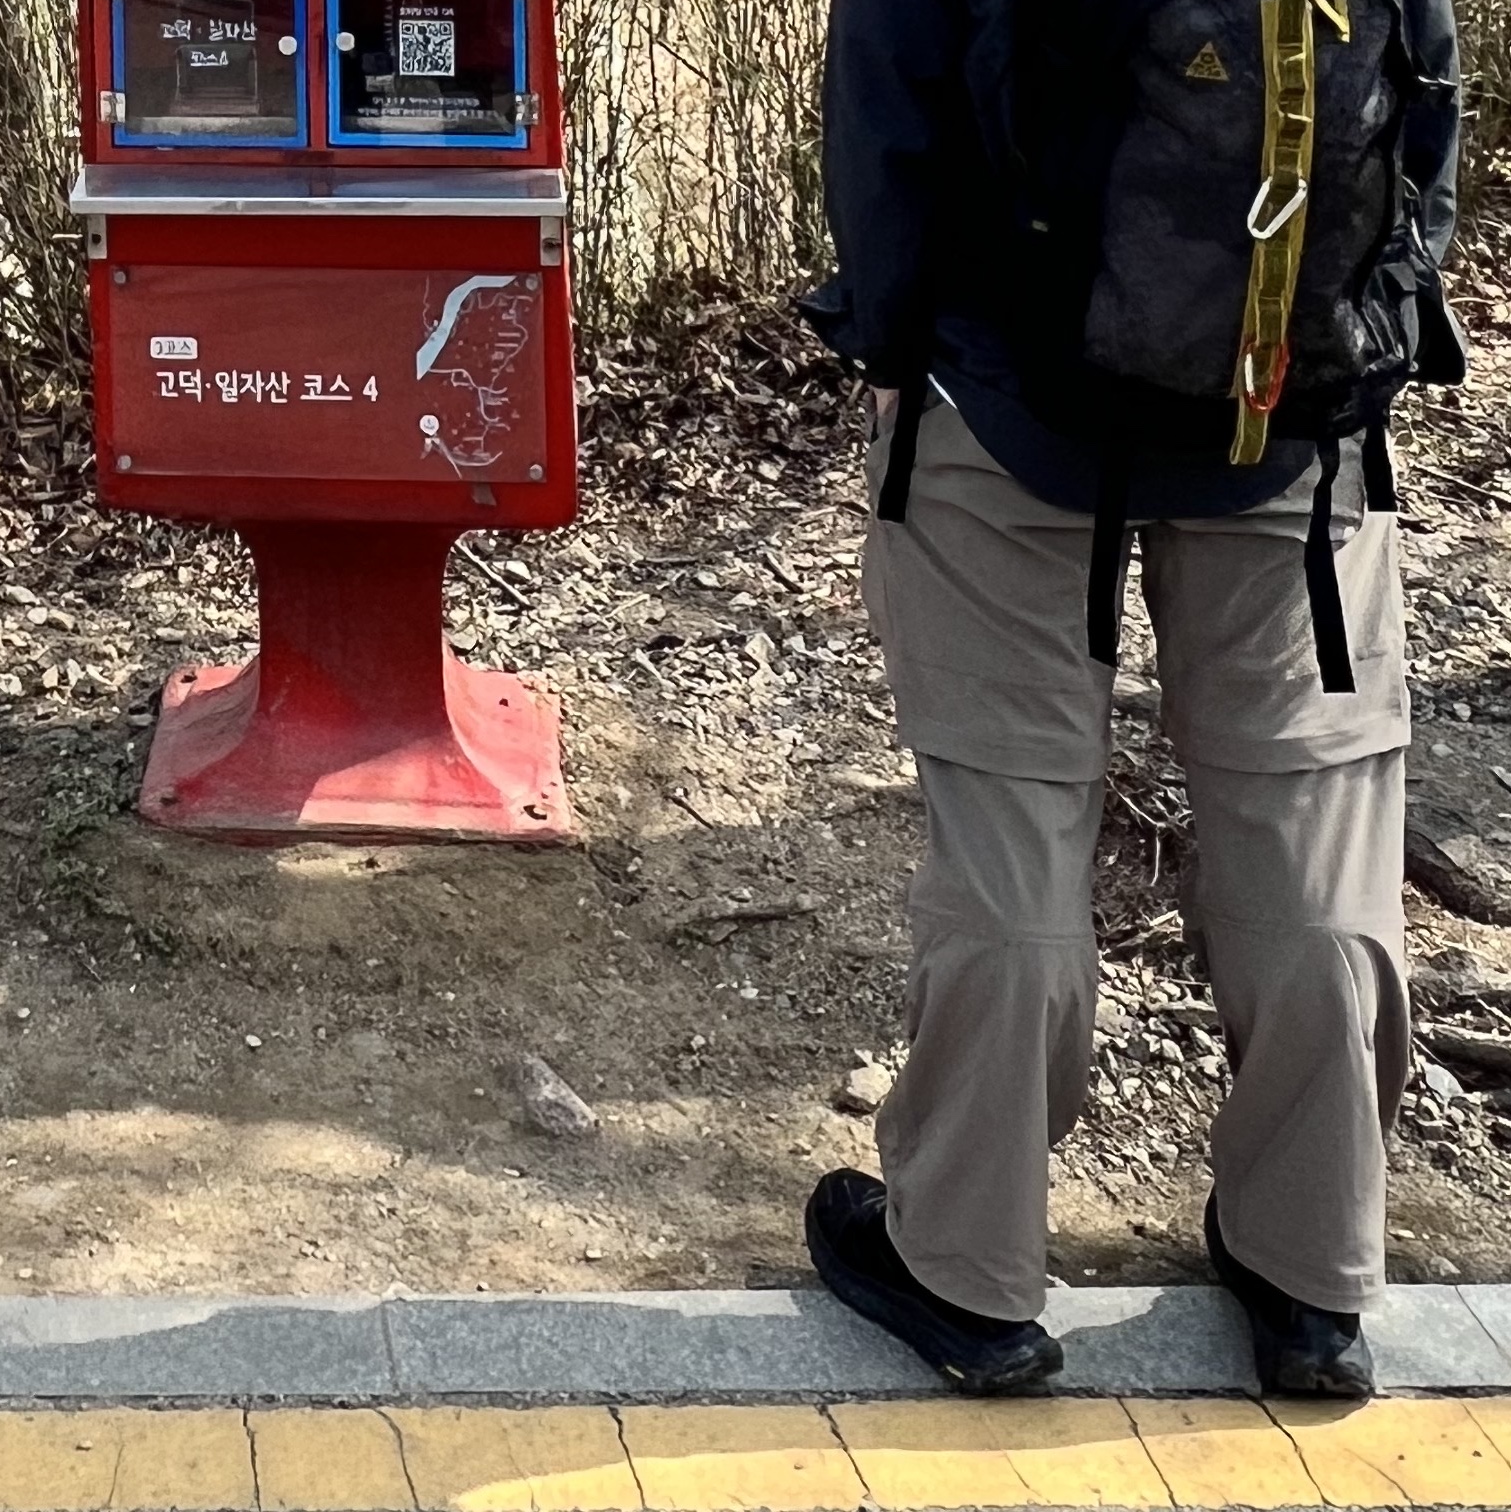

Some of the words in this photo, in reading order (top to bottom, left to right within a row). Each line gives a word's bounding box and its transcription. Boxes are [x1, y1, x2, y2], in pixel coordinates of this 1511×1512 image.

[155, 368, 292, 403] 고덕·일자산
[300, 373, 353, 402] 코스
[362, 374, 379, 403] 4
